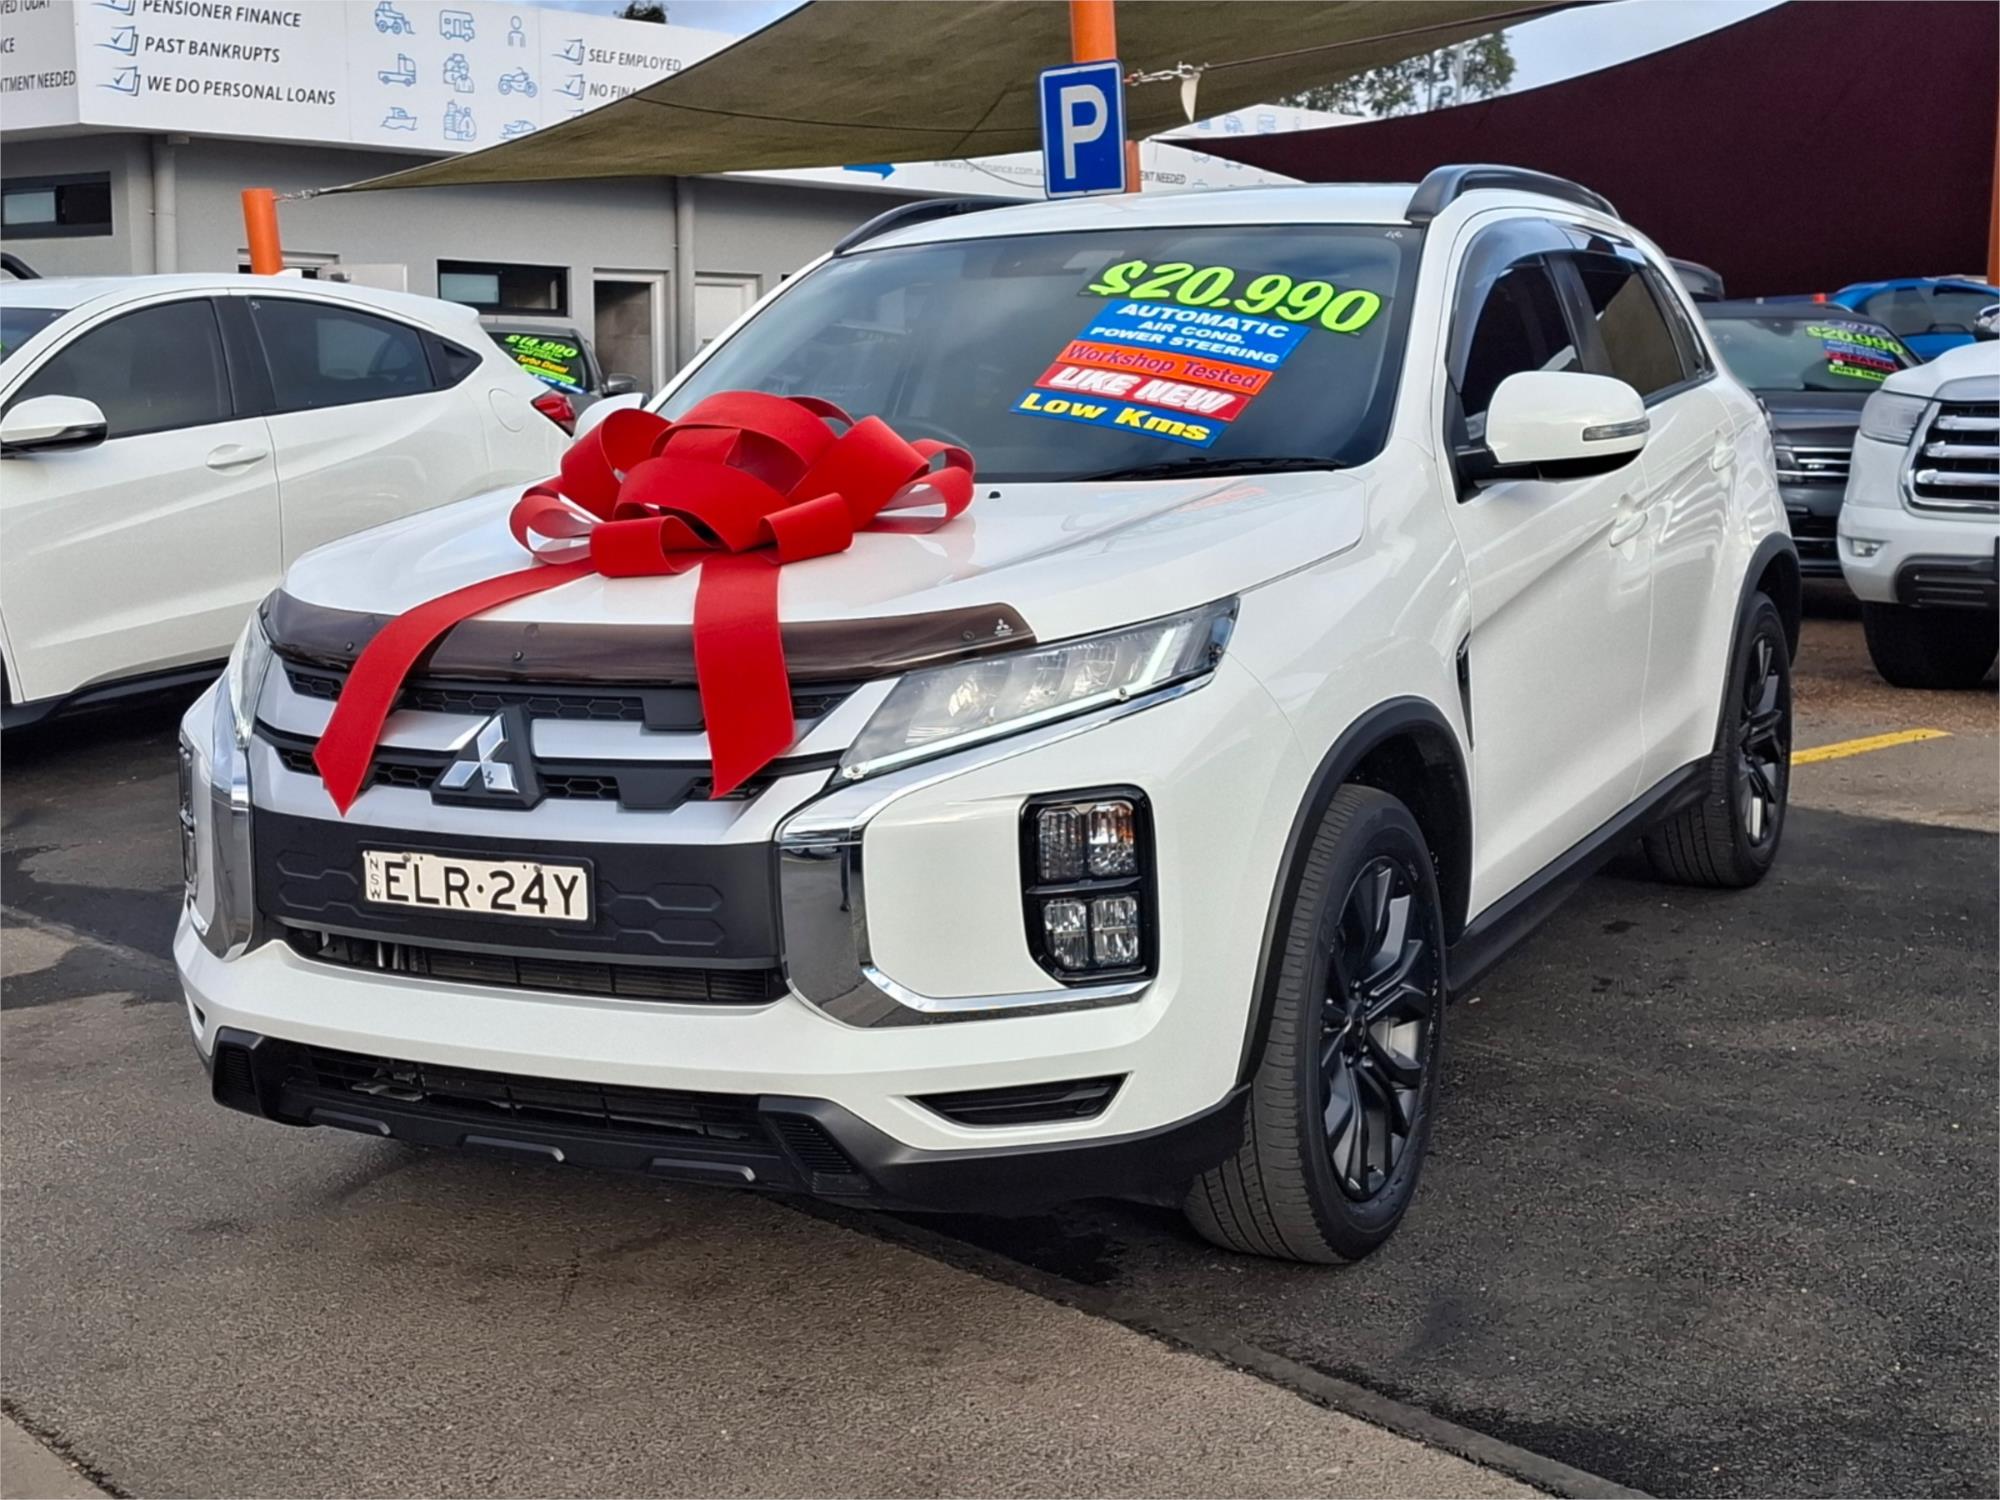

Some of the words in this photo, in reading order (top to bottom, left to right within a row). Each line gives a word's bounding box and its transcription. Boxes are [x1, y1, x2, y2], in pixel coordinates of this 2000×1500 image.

[143, 0, 232, 20] PENSIONER
[235, 7, 302, 28] FINANCE
[145, 36, 185, 54] PAST
[188, 40, 281, 63] BANKRUPTS
[588, 48, 617, 64] SELF
[618, 52, 682, 72] EMPLOYED
[38, 70, 76, 88] NEEDED
[147, 75, 172, 92] WE
[175, 78, 200, 94] DO
[203, 80, 283, 102] PERSONAL
[286, 87, 336, 105] LOANS
[589, 83, 608, 97] NO
[1060, 84, 1108, 180] P
[1155, 172, 1186, 185] NEEDED
[1115, 303, 1290, 339] AUTOMATIC
[1138, 321, 1177, 333] AIR
[1181, 326, 1245, 344] COND.
[1090, 327, 1166, 343] POWER
[1169, 336, 1279, 364] STEERING
[1067, 345, 1175, 374] Workshop
[1182, 361, 1260, 388] Tested
[1049, 367, 1141, 395] LIKE
[1133, 379, 1236, 414] NEW
[1114, 408, 1212, 441] Kms
[370, 858, 381, 899] NSW
